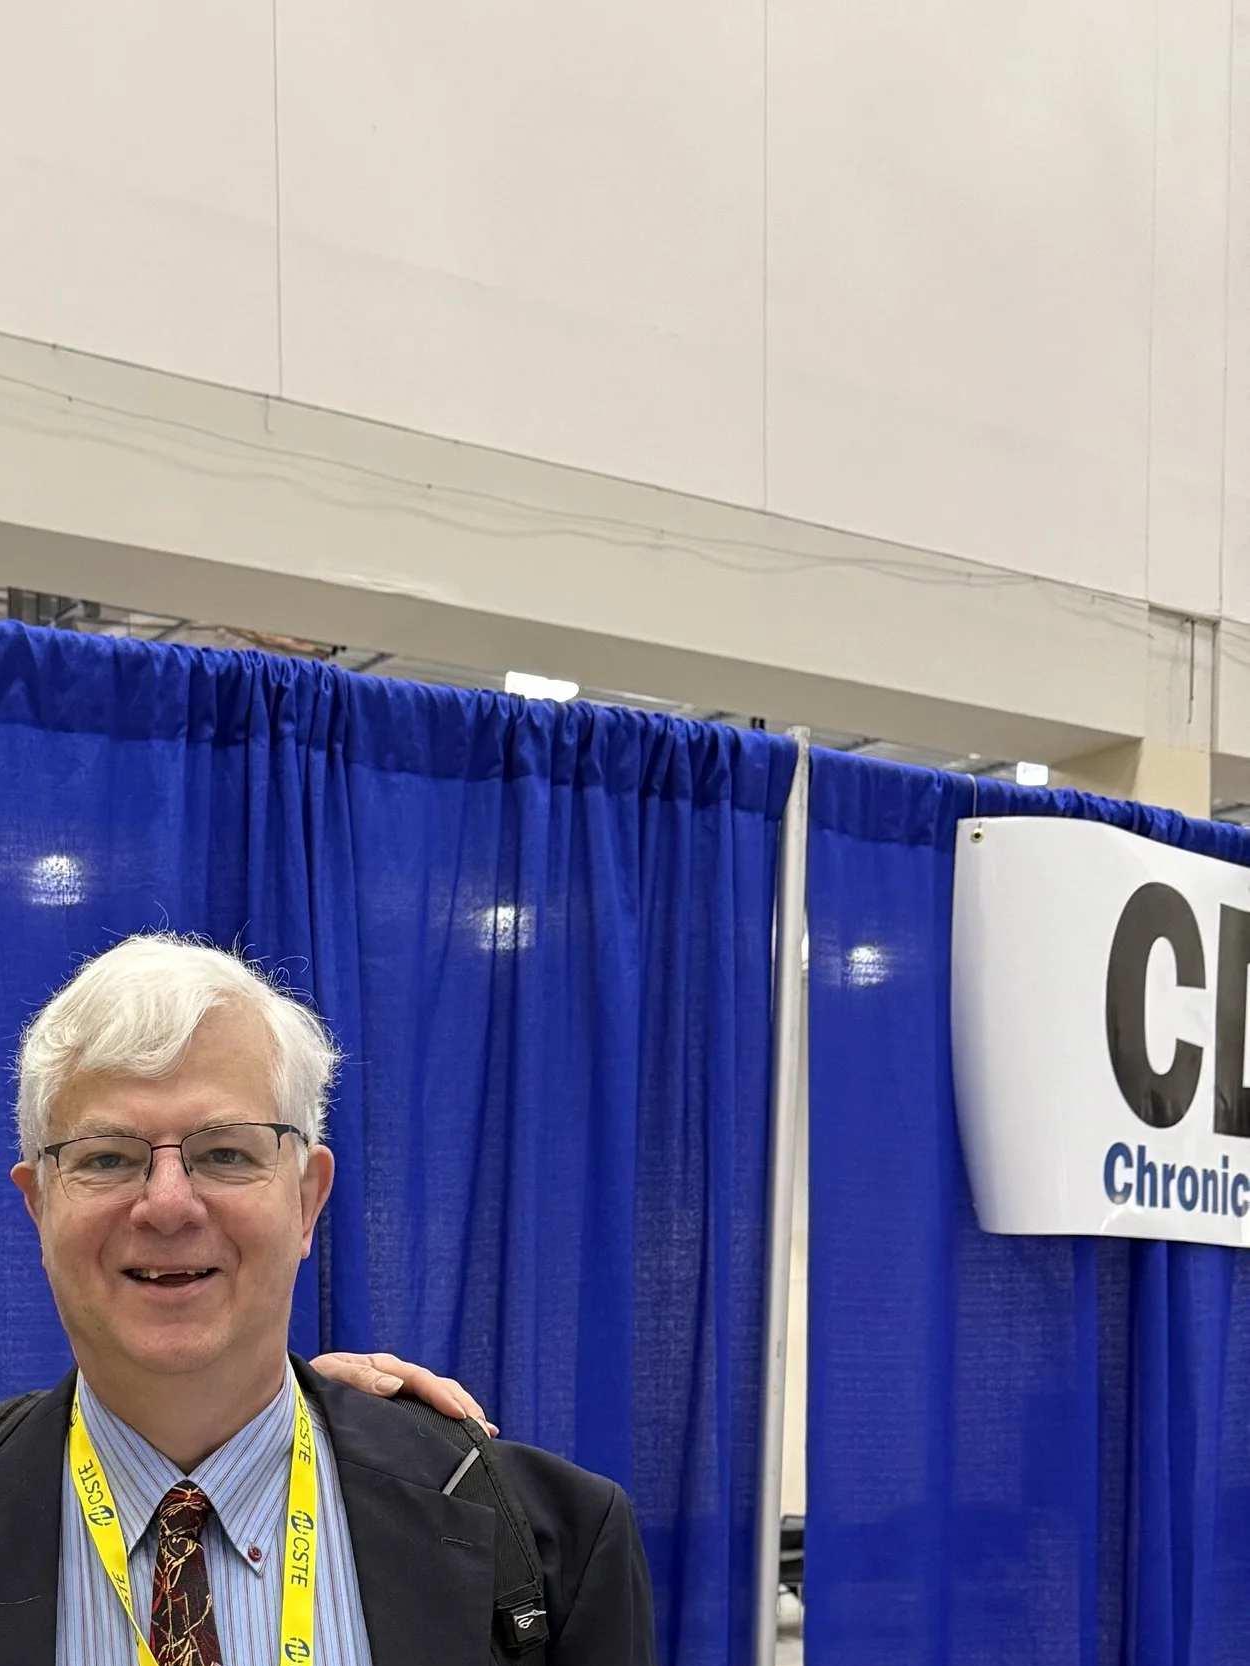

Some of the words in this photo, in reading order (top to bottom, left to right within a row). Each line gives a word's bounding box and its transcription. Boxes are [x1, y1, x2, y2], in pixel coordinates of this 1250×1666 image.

[1103, 1141, 1250, 1218] Chronic
[298, 1416, 311, 1466] CSTE
[78, 1459, 104, 1505] CSTE
[291, 1537, 310, 1588] CSTE
